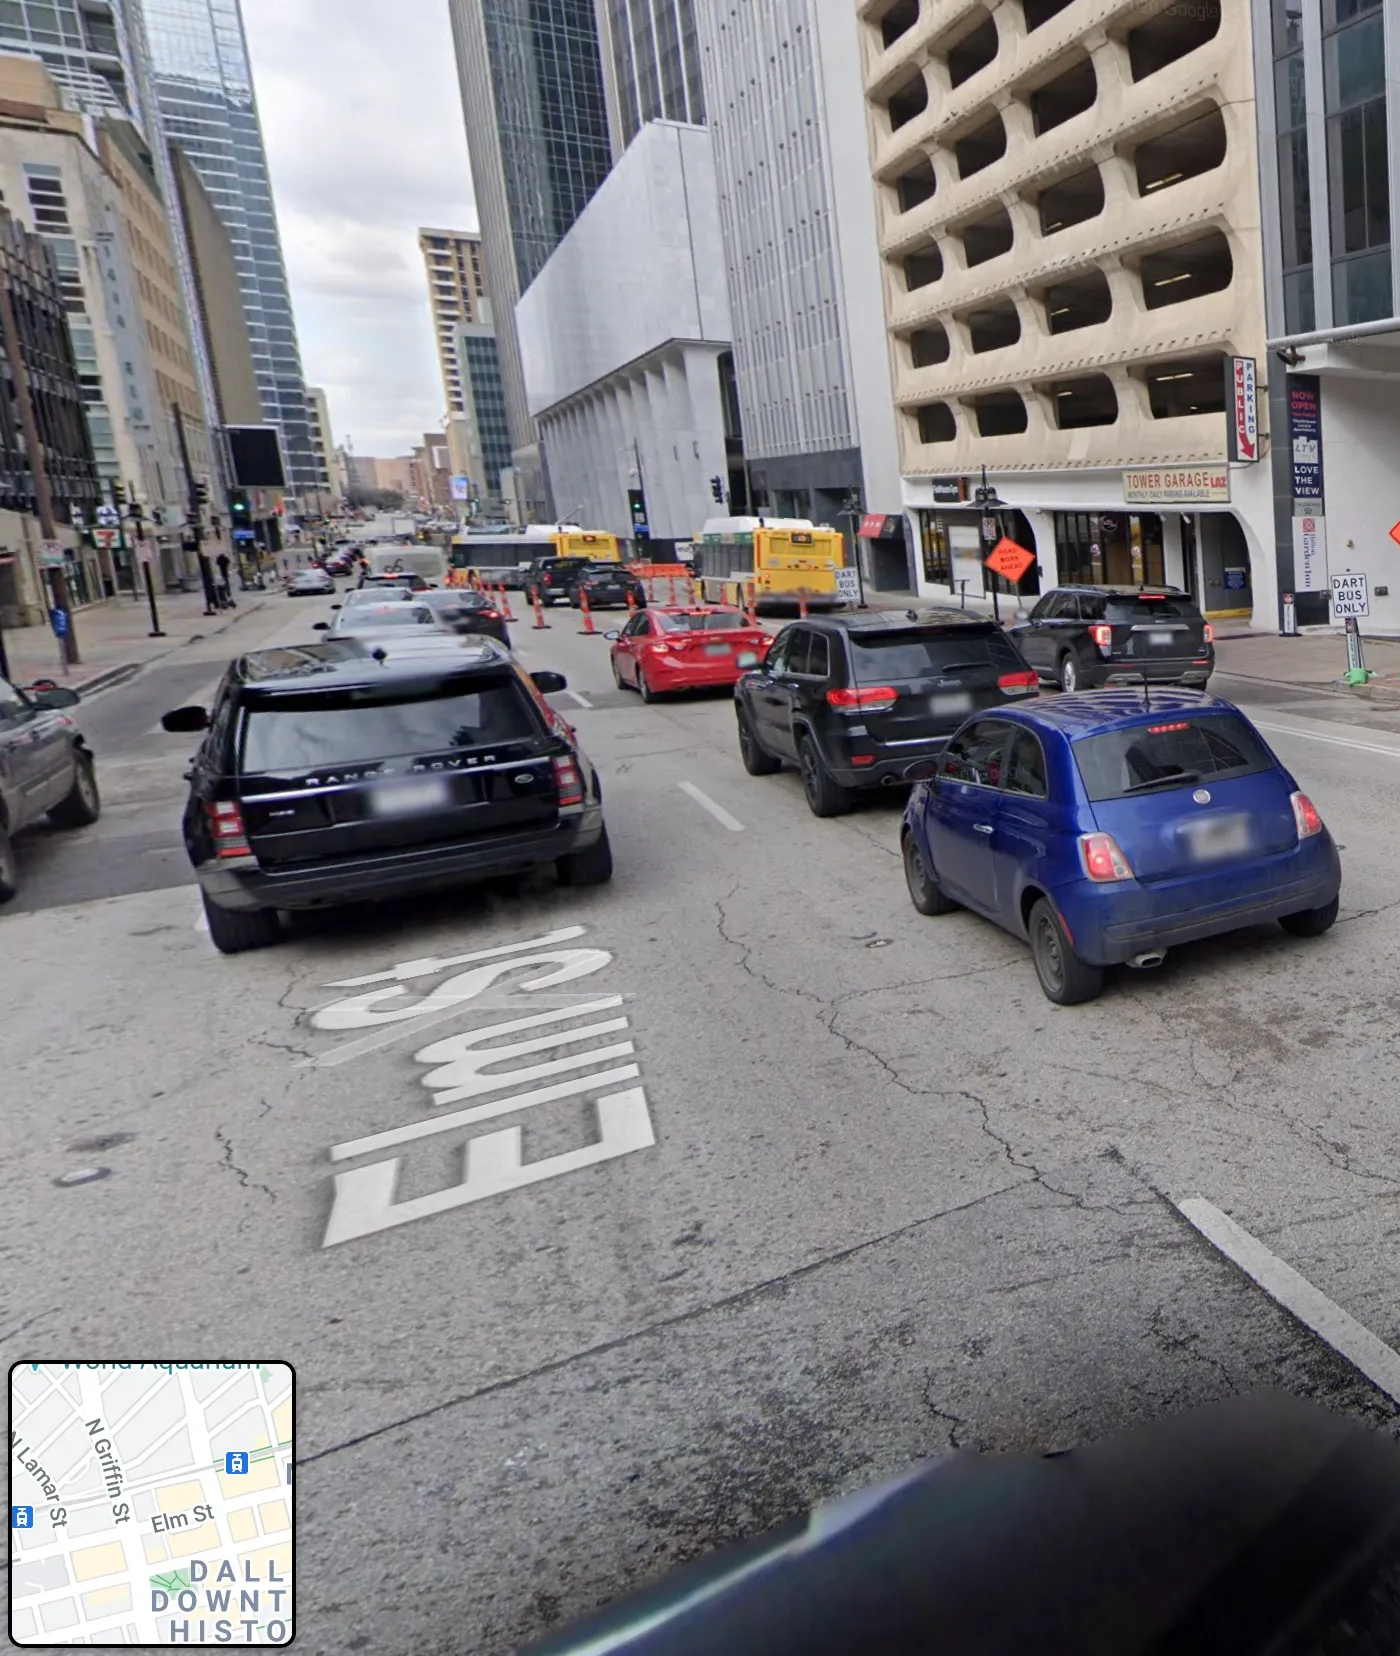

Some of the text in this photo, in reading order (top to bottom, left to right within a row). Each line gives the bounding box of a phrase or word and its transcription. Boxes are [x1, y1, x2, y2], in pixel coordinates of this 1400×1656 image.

[1236, 361, 1246, 433] PUBLIC
[1246, 362, 1255, 433] PARKING
[1292, 391, 1315, 400] NOW
[1291, 401, 1317, 411] OPEN
[1295, 443, 1316, 453] LTV
[1294, 466, 1319, 474] LOVE
[1126, 471, 1209, 489] TOWER GARAGE
[1294, 476, 1313, 485] THE
[1294, 487, 1320, 495] VIEW
[840, 580, 856, 589] BUS
[1333, 578, 1364, 589] DART
[838, 589, 860, 598] ONLY
[1338, 590, 1362, 601] BUS
[1335, 602, 1366, 614] ONLY
[305, 754, 496, 786] RANGE ROVER
[310, 924, 656, 1248] Elm St
